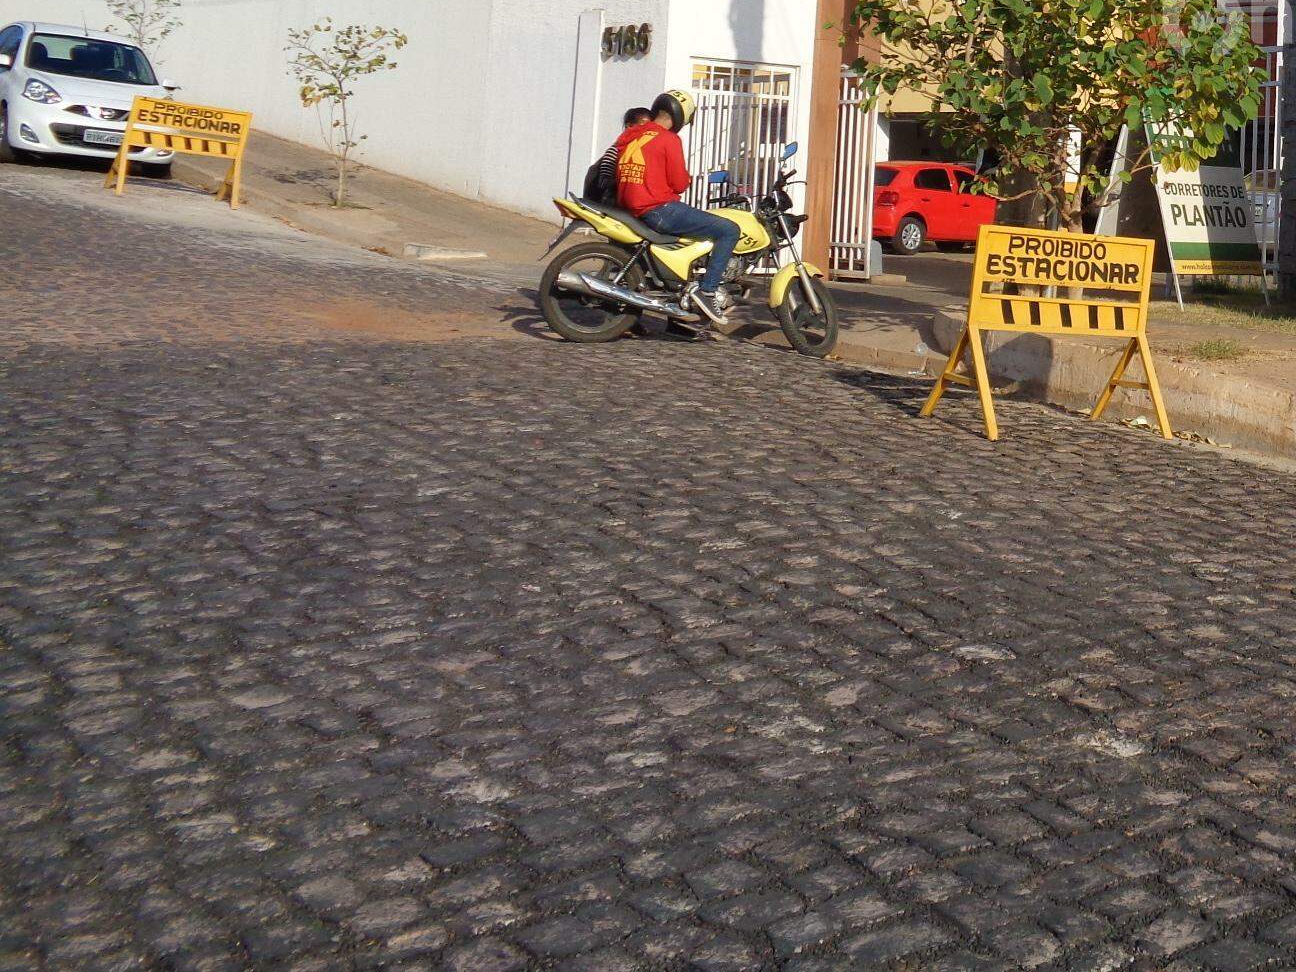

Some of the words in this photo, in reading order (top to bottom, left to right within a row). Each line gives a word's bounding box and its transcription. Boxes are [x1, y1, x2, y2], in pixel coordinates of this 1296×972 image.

[137, 108, 241, 135] ESTACIONAR
[153, 101, 223, 120] PROIBIDO
[1231, 185, 1245, 199] DE
[1170, 202, 1247, 229] PLANTÃO
[1007, 235, 1107, 261] PROIBIDO
[986, 254, 1141, 285] ESTACIONAR
